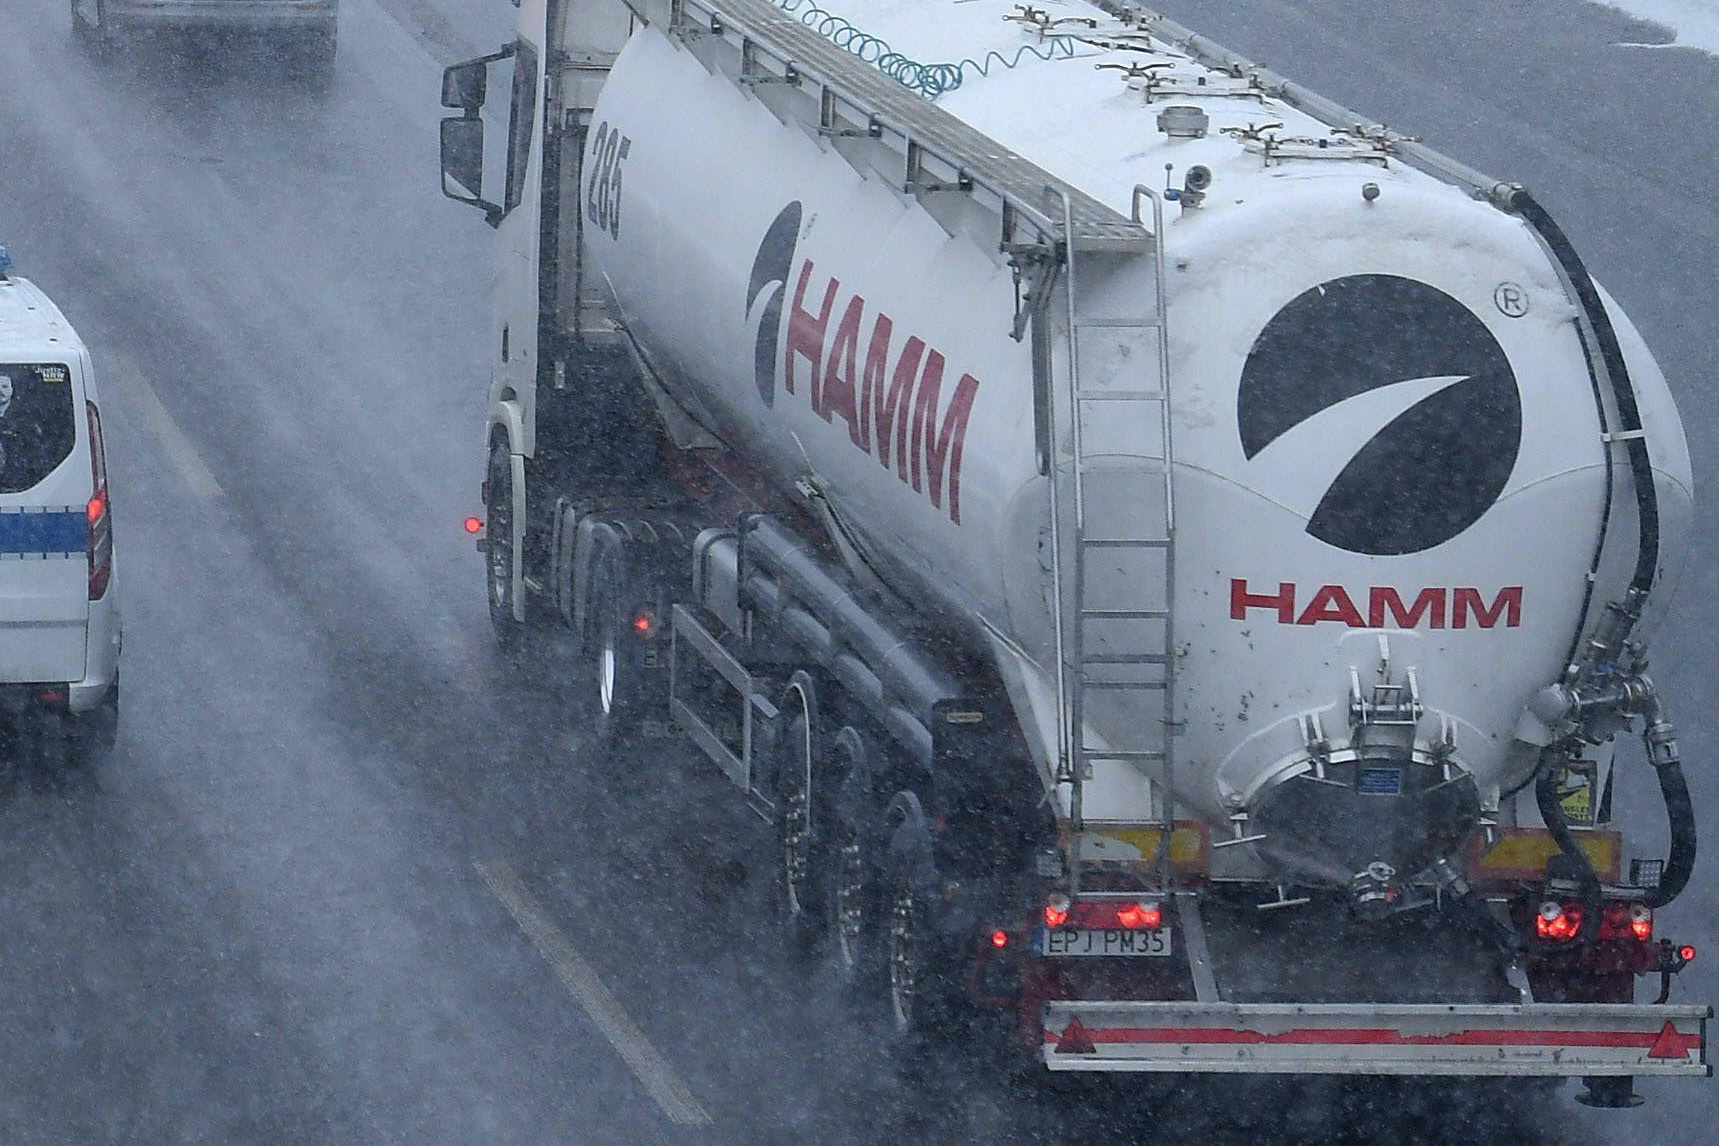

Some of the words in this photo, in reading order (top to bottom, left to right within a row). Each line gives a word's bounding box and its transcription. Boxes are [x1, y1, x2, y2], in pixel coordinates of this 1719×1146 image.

[588, 120, 632, 242] 285
[785, 258, 980, 527] HAMM
[1229, 578, 1524, 629] HAMM
